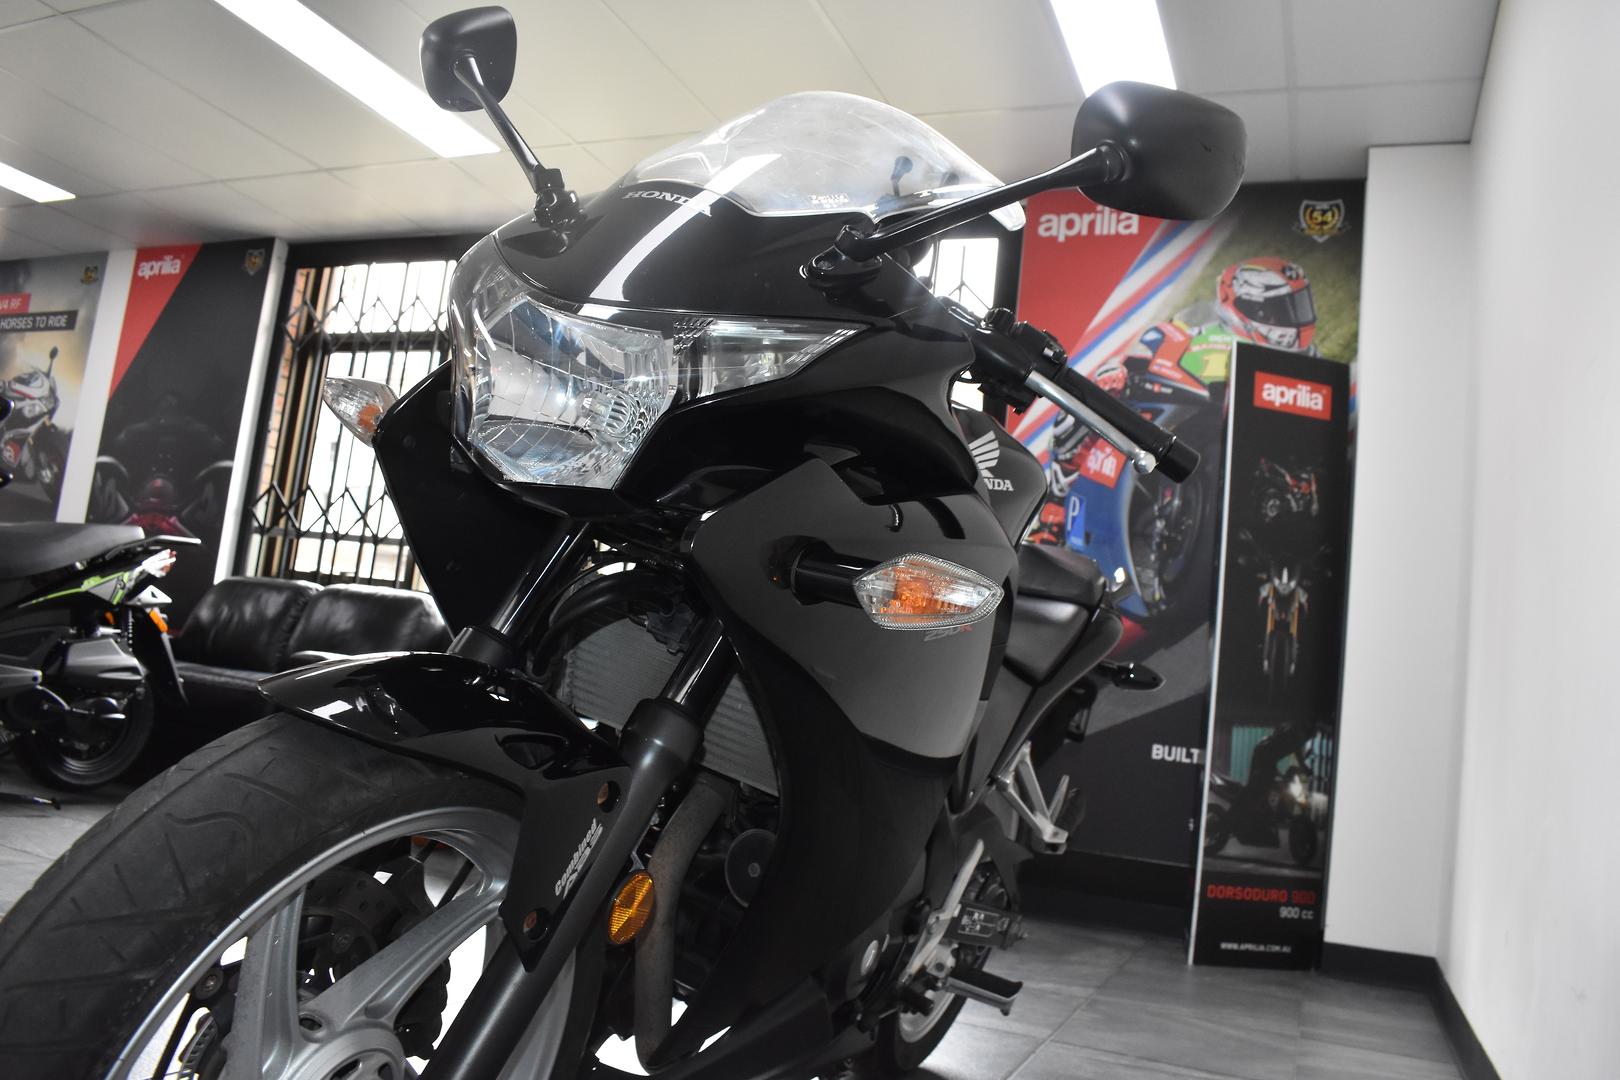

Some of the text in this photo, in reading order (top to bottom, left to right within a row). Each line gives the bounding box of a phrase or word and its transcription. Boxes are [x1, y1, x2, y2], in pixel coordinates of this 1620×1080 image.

[1037, 204, 1139, 243] aprilia
[137, 255, 182, 280] aprilia
[0, 314, 68, 330] HORSES TO RIDE
[1261, 382, 1324, 411] aprilia
[983, 478, 1014, 491] NDA
[1152, 743, 1200, 764] BUILT
[1207, 884, 1288, 903] DORSODURO
[1279, 906, 1300, 919] 900
